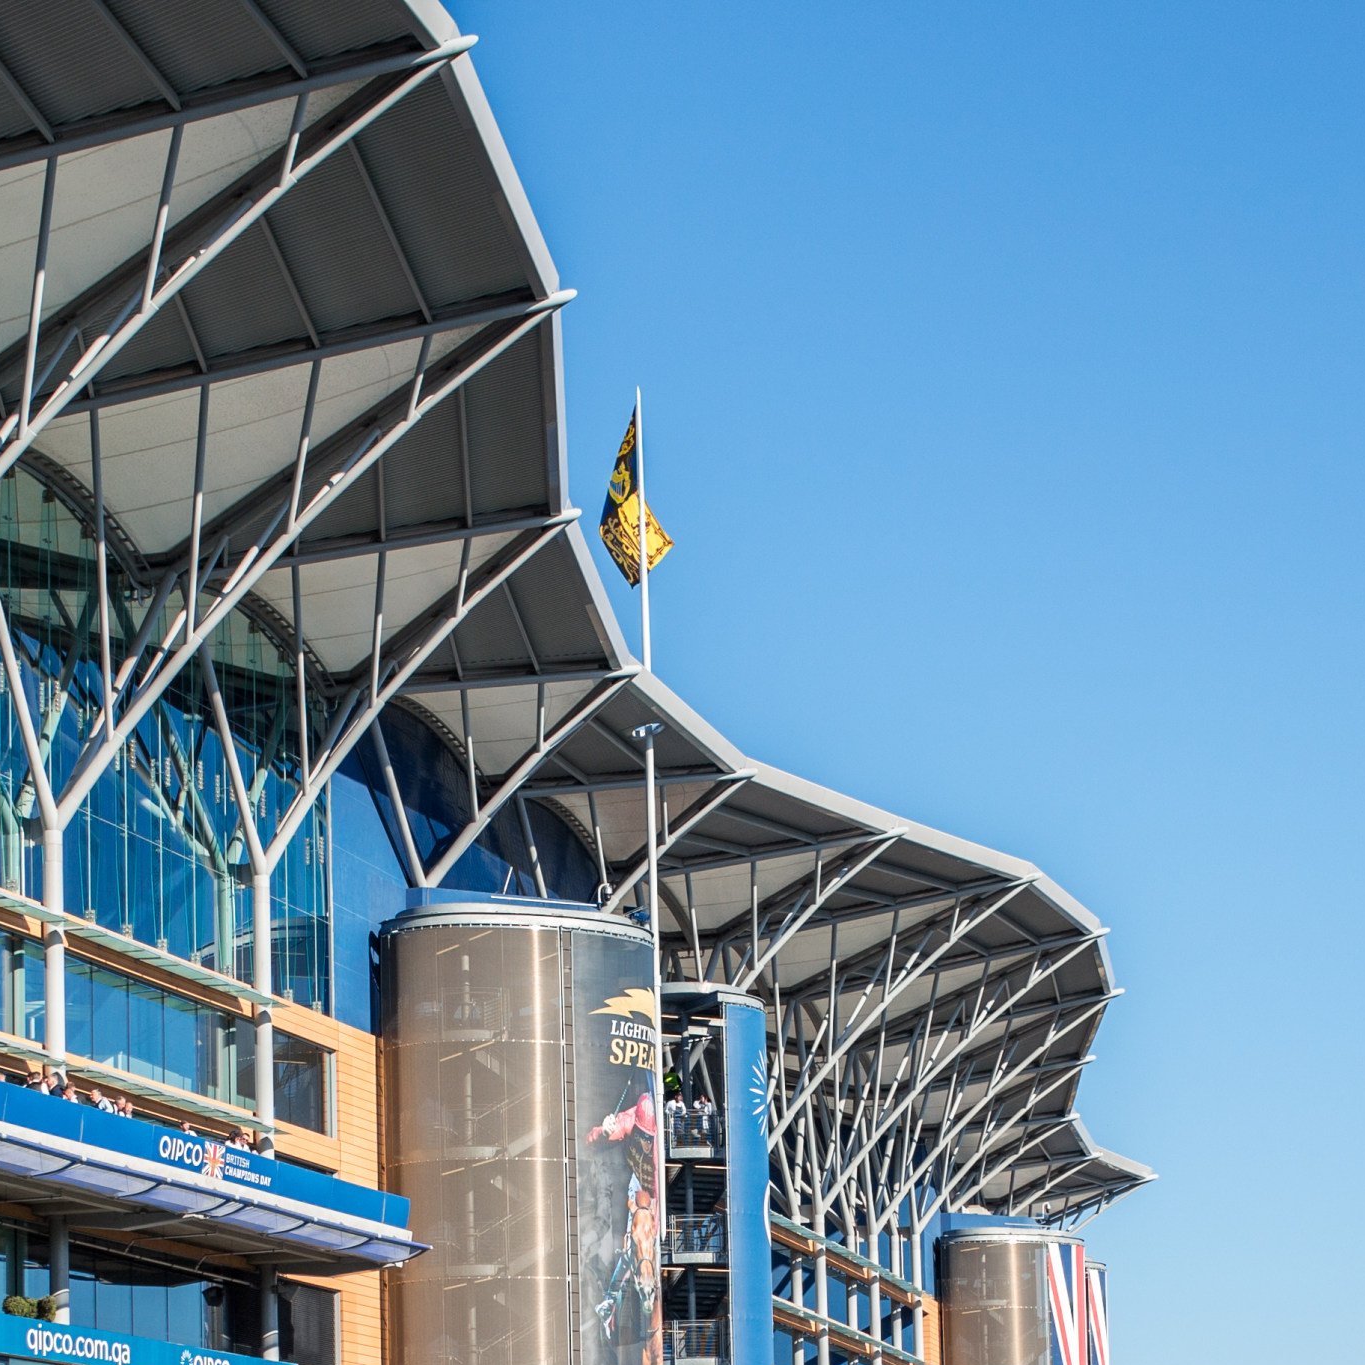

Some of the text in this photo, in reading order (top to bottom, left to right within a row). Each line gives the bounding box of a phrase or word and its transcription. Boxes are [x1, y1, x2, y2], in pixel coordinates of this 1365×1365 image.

[609, 1038, 656, 1073] SPEA
[159, 1135, 203, 1167] QIPCO
[226, 1153, 250, 1169] BRITISH
[225, 1165, 272, 1187] CHAMPIONS DAY
